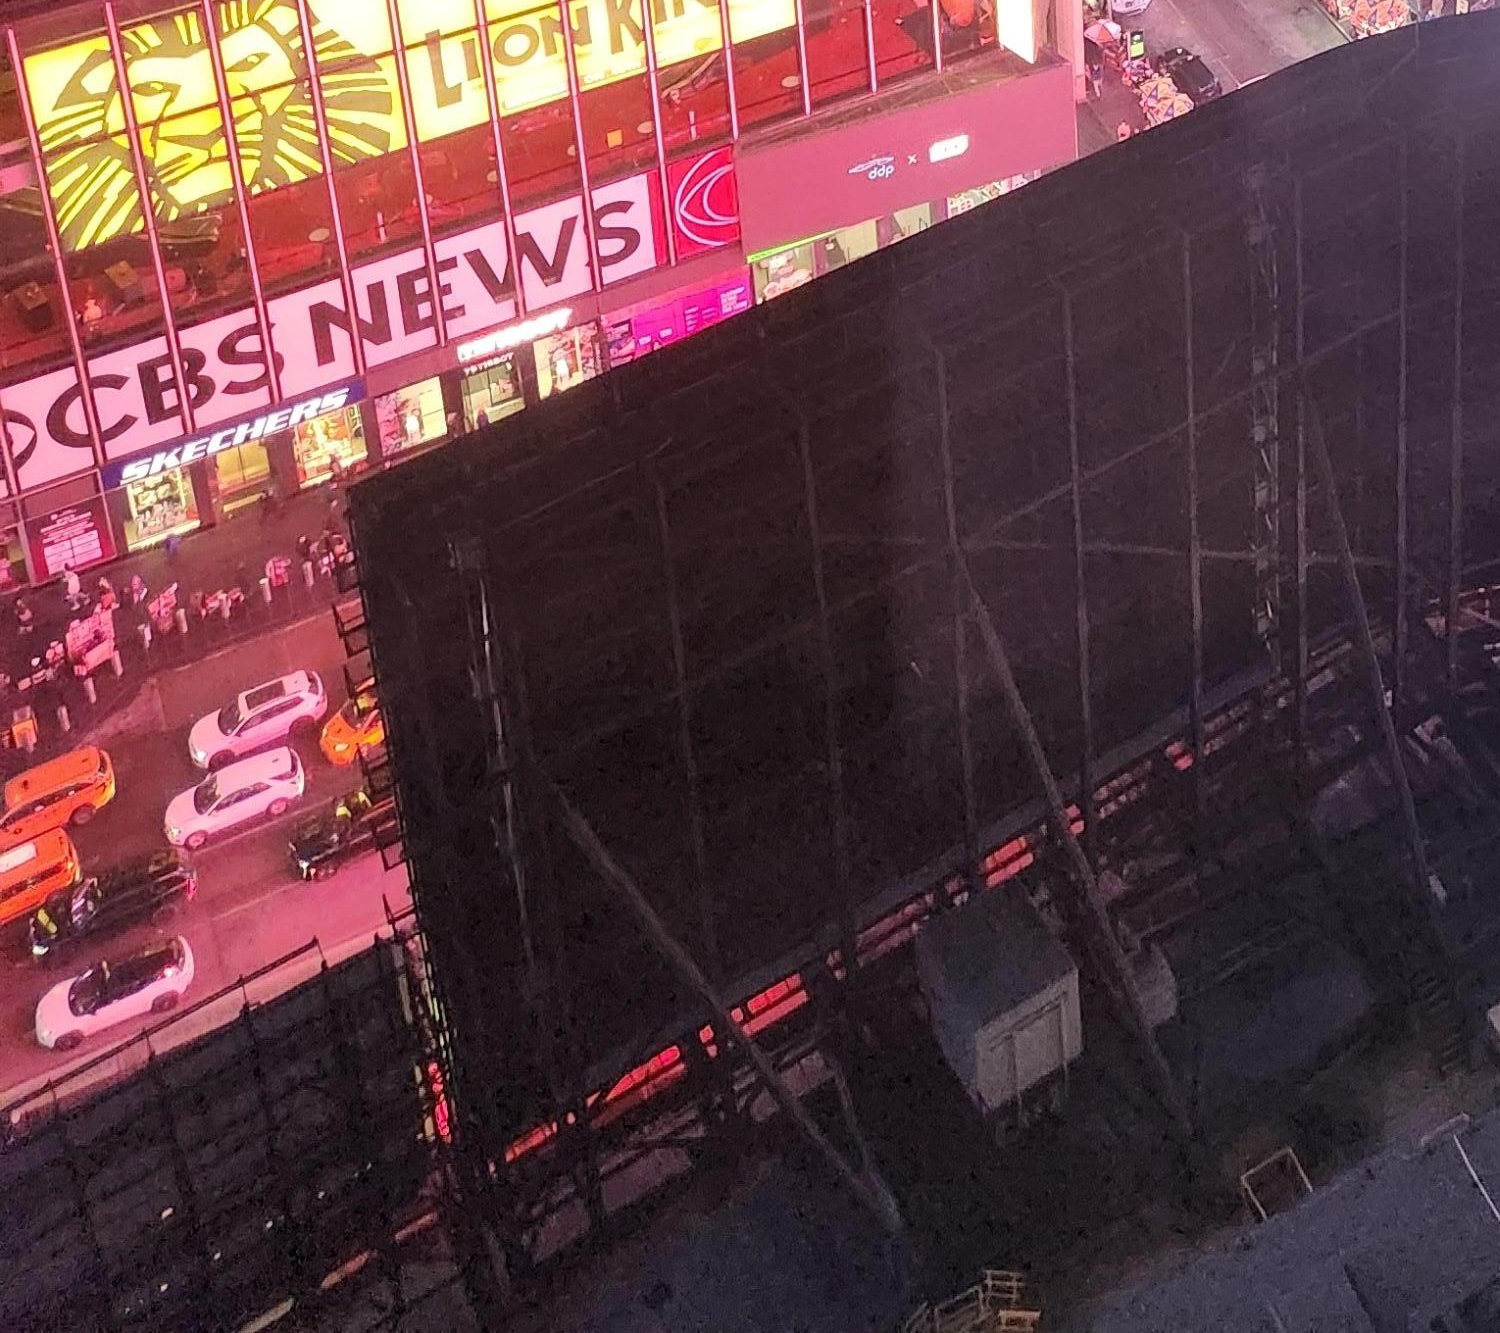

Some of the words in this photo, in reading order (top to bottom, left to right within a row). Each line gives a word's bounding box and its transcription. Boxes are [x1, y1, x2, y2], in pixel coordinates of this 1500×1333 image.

[425, 4, 592, 109] LION
[46, 322, 285, 448] CBS
[308, 200, 641, 367] NEWS
[119, 387, 350, 486] SKECHERS
